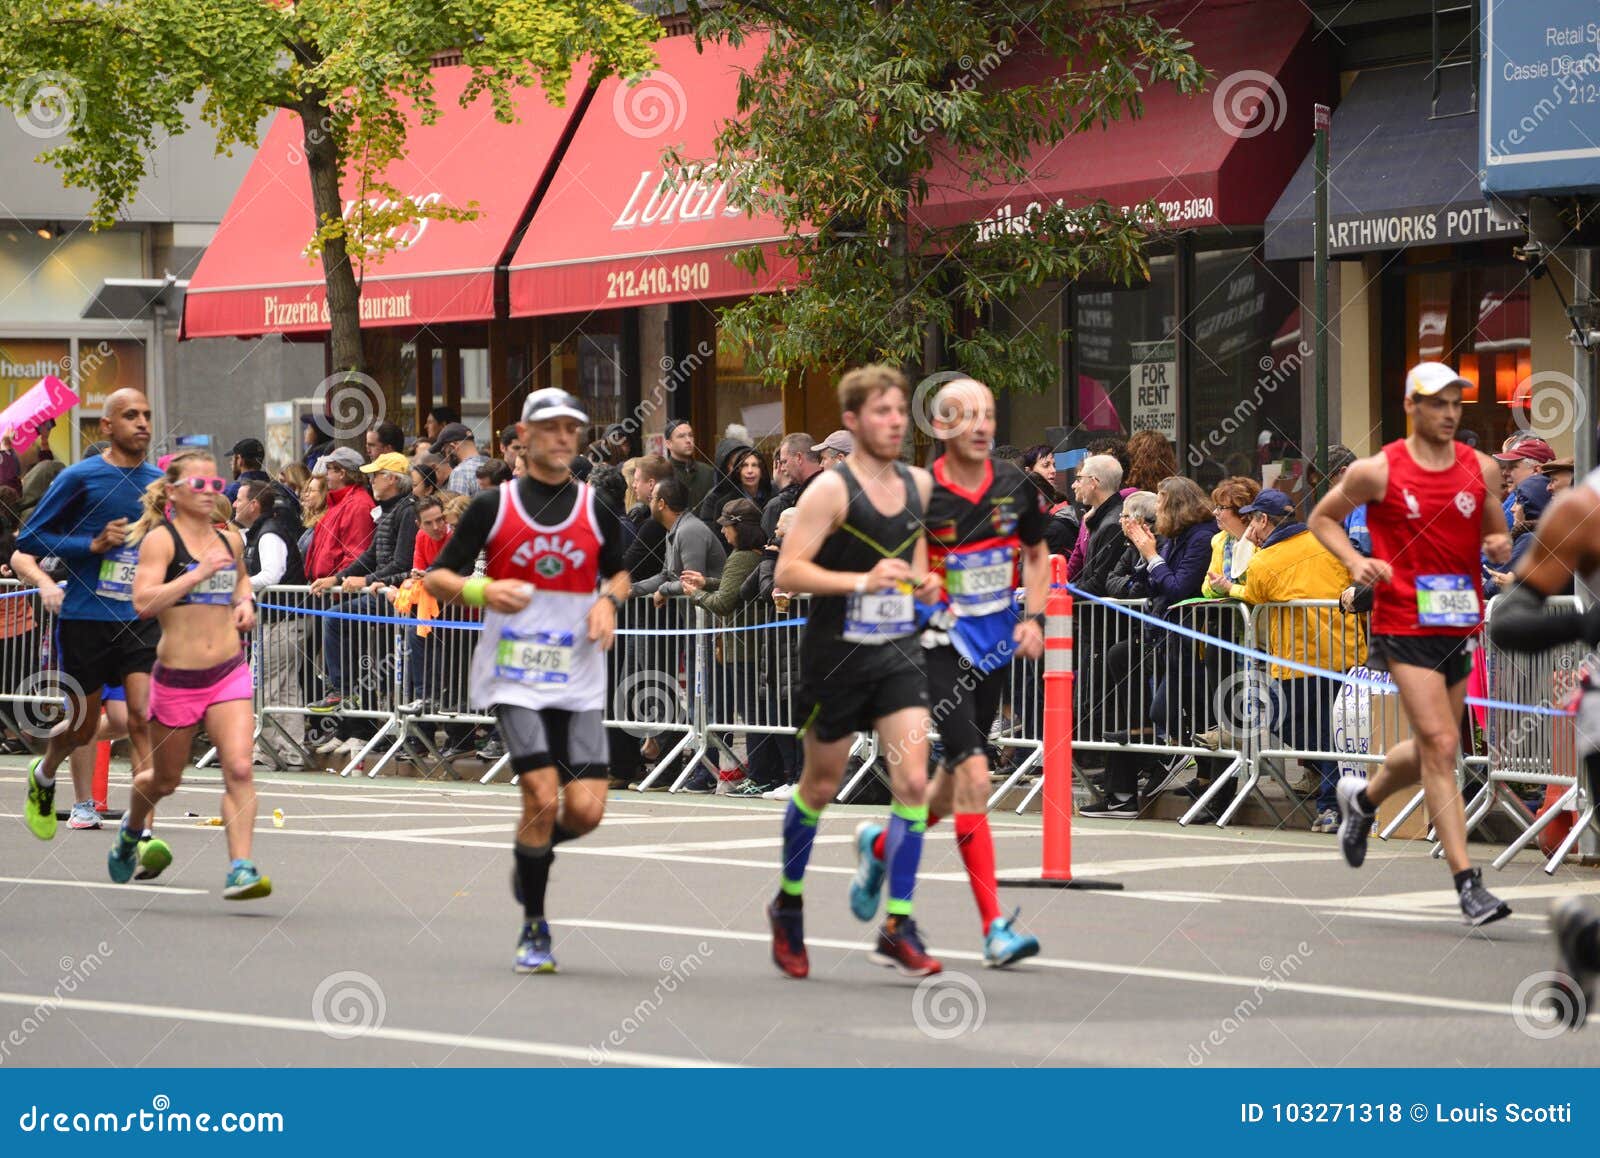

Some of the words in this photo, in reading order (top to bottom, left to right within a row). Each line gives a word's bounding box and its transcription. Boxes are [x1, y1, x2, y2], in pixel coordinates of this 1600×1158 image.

[1546, 26, 1584, 47] Retail
[1503, 60, 1549, 81] Cassie
[1329, 213, 1437, 247] ARTHWORKS
[607, 262, 709, 298] 212.410.1910
[264, 295, 318, 326] Pizzeria
[0, 360, 60, 378] health
[1141, 364, 1166, 385] FOR
[1138, 385, 1170, 407] RENT
[511, 535, 586, 569] ITALIA
